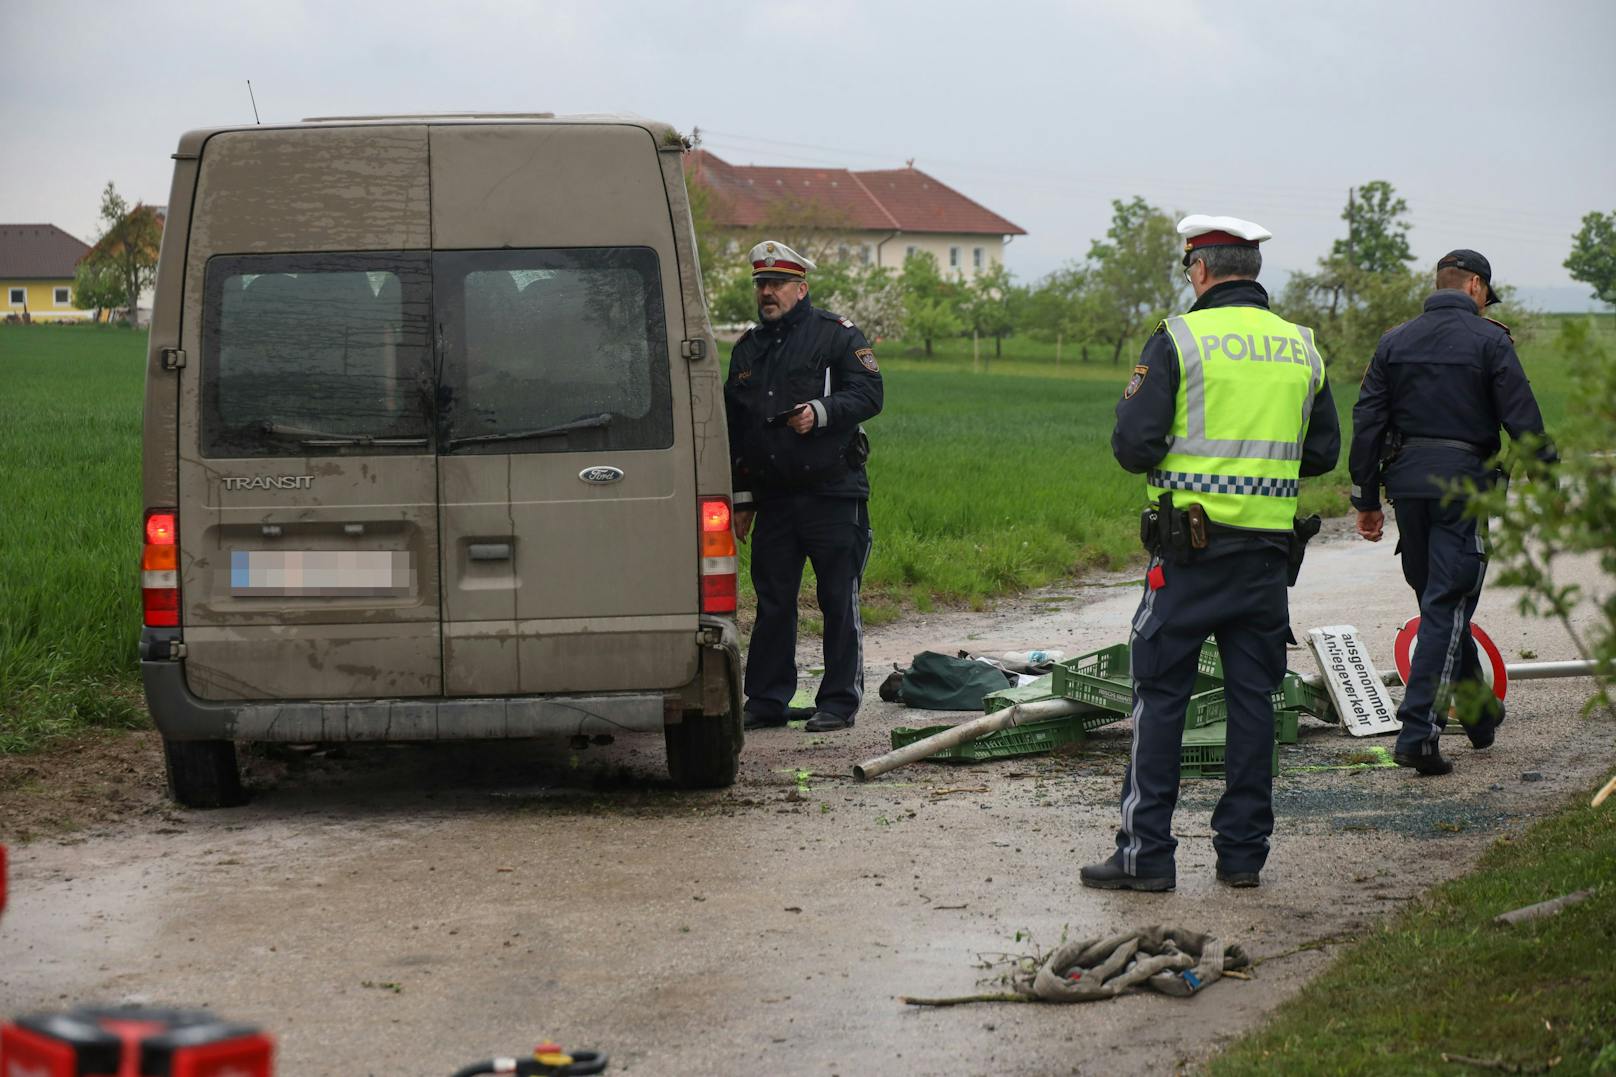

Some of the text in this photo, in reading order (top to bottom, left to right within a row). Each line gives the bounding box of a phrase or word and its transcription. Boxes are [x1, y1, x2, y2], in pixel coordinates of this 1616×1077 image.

[222, 475, 315, 490] TRANSIT
[588, 469, 615, 481] Ford
[1322, 632, 1371, 727] Anliegeverkehr
[1341, 633, 1391, 723] ausgenommen
